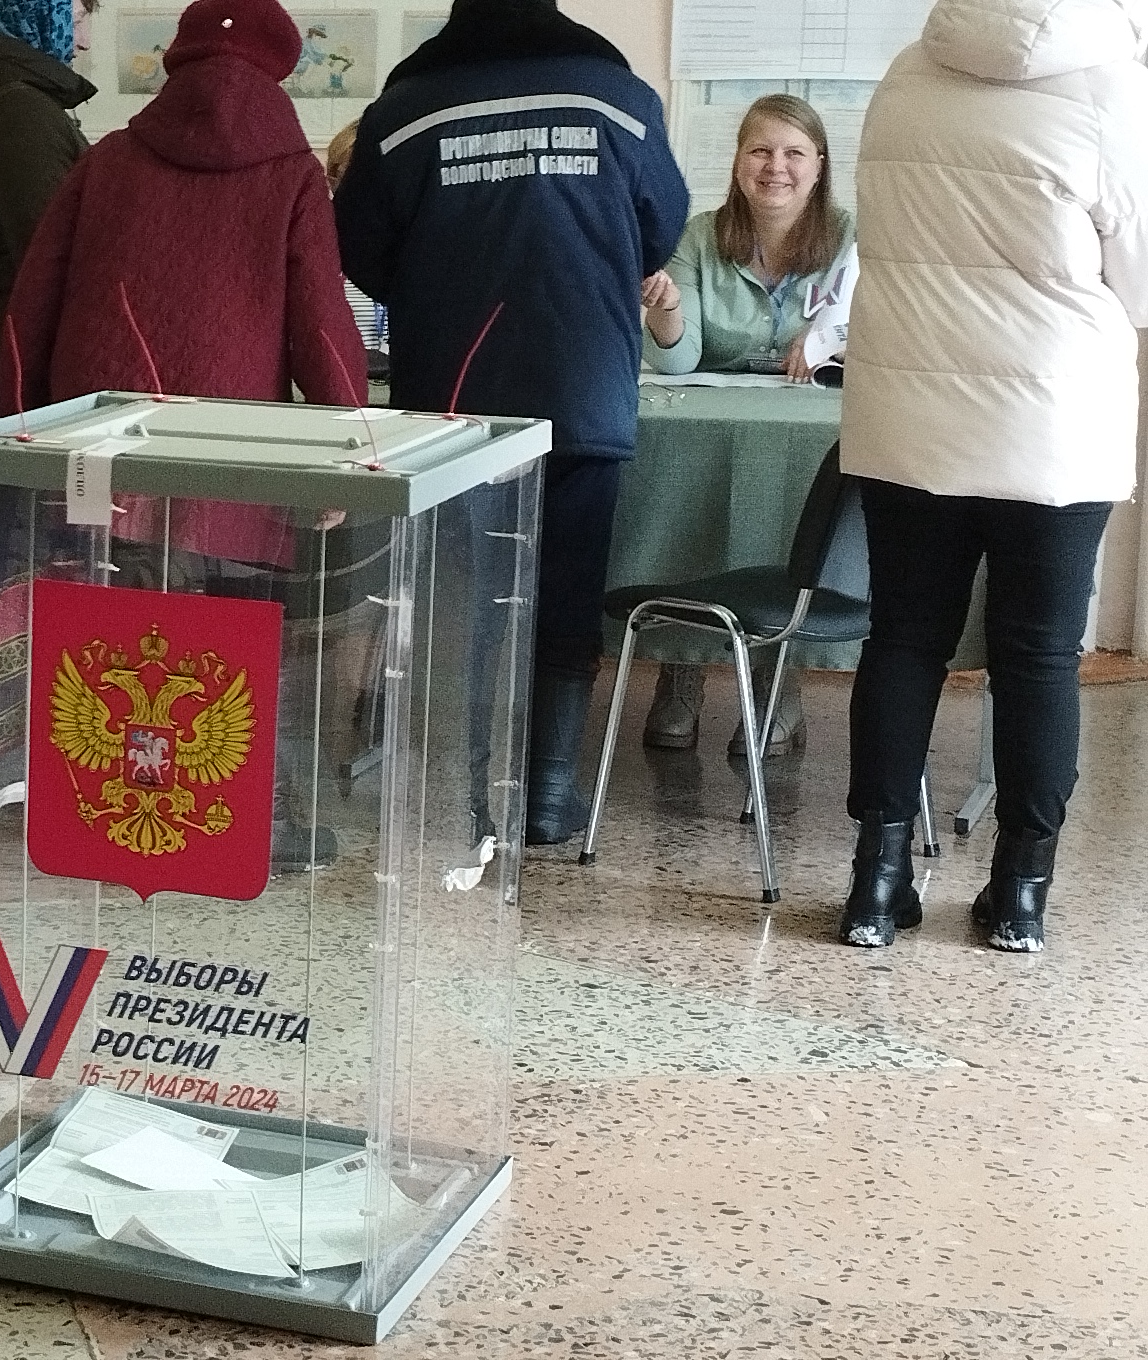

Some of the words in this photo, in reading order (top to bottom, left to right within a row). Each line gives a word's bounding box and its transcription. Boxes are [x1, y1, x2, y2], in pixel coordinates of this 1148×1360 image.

[440, 153, 536, 186] ВОЛОГОДСКОЙ
[538, 154, 599, 176] ОБЛАСТИ
[123, 954, 270, 998] ВЫБОРЫ
[106, 991, 311, 1044] ПРЕЗИДЕНТА
[90, 1028, 221, 1070] РОССИИ
[145, 1073, 217, 1105] МАРТА
[222, 1083, 280, 1114] 2024
